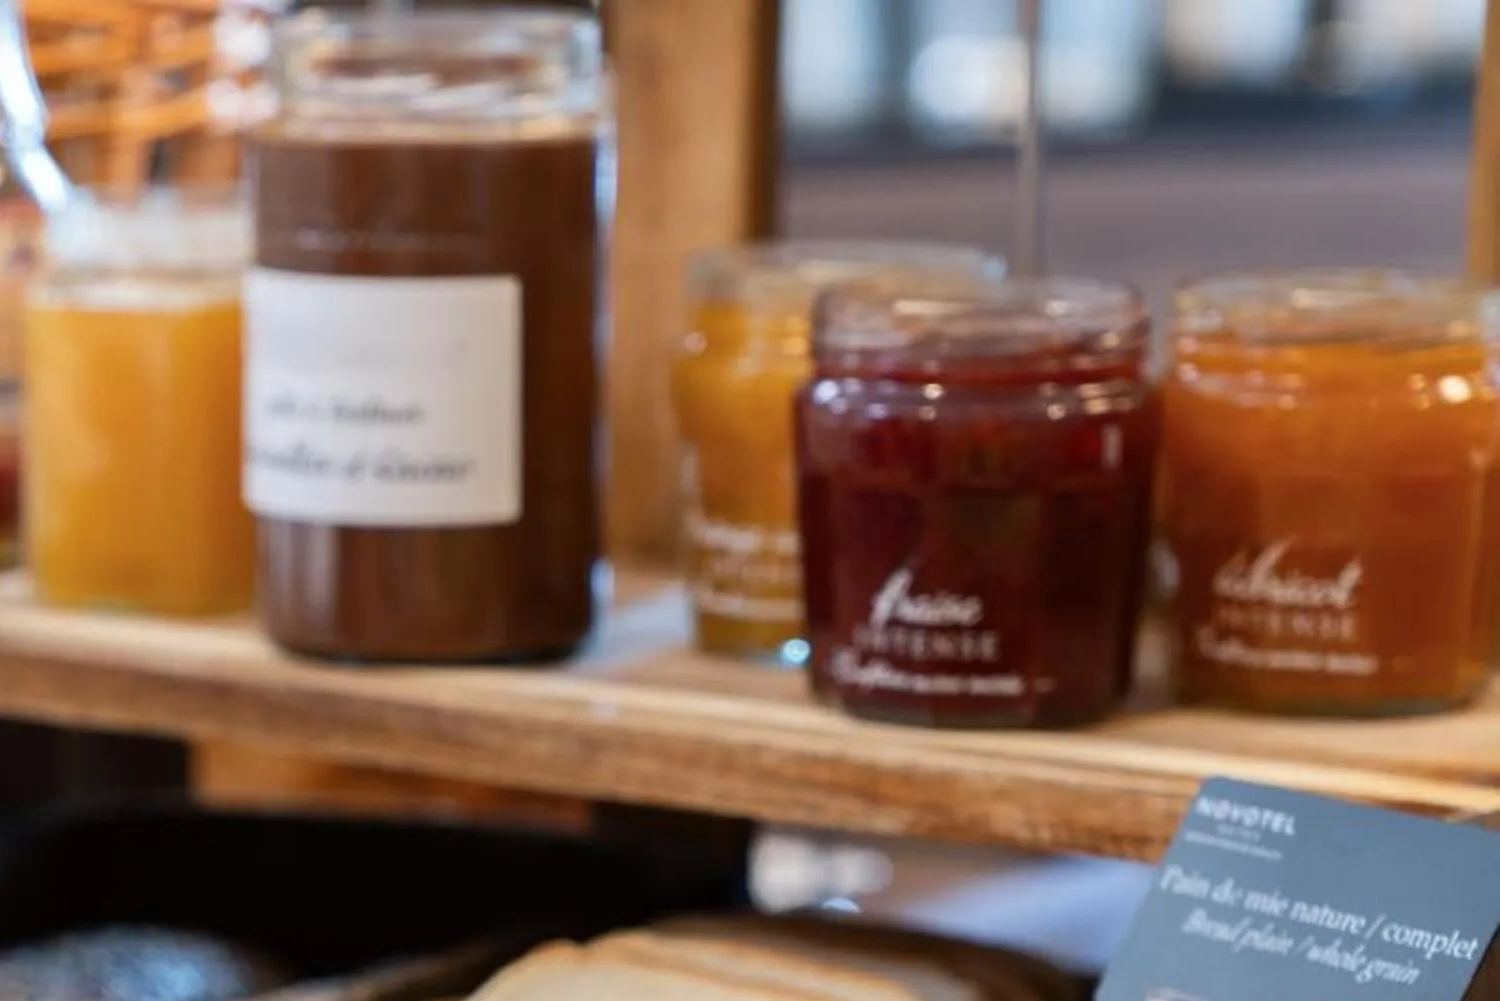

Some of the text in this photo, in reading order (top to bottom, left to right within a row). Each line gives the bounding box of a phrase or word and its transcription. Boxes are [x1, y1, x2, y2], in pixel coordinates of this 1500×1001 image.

[1197, 796, 1296, 837] NOVOTEL
[1159, 863, 1211, 899] Pain
[1211, 877, 1243, 907] de
[1243, 886, 1290, 917] mie
[1290, 900, 1366, 934] nature
[1381, 922, 1480, 960] complet
